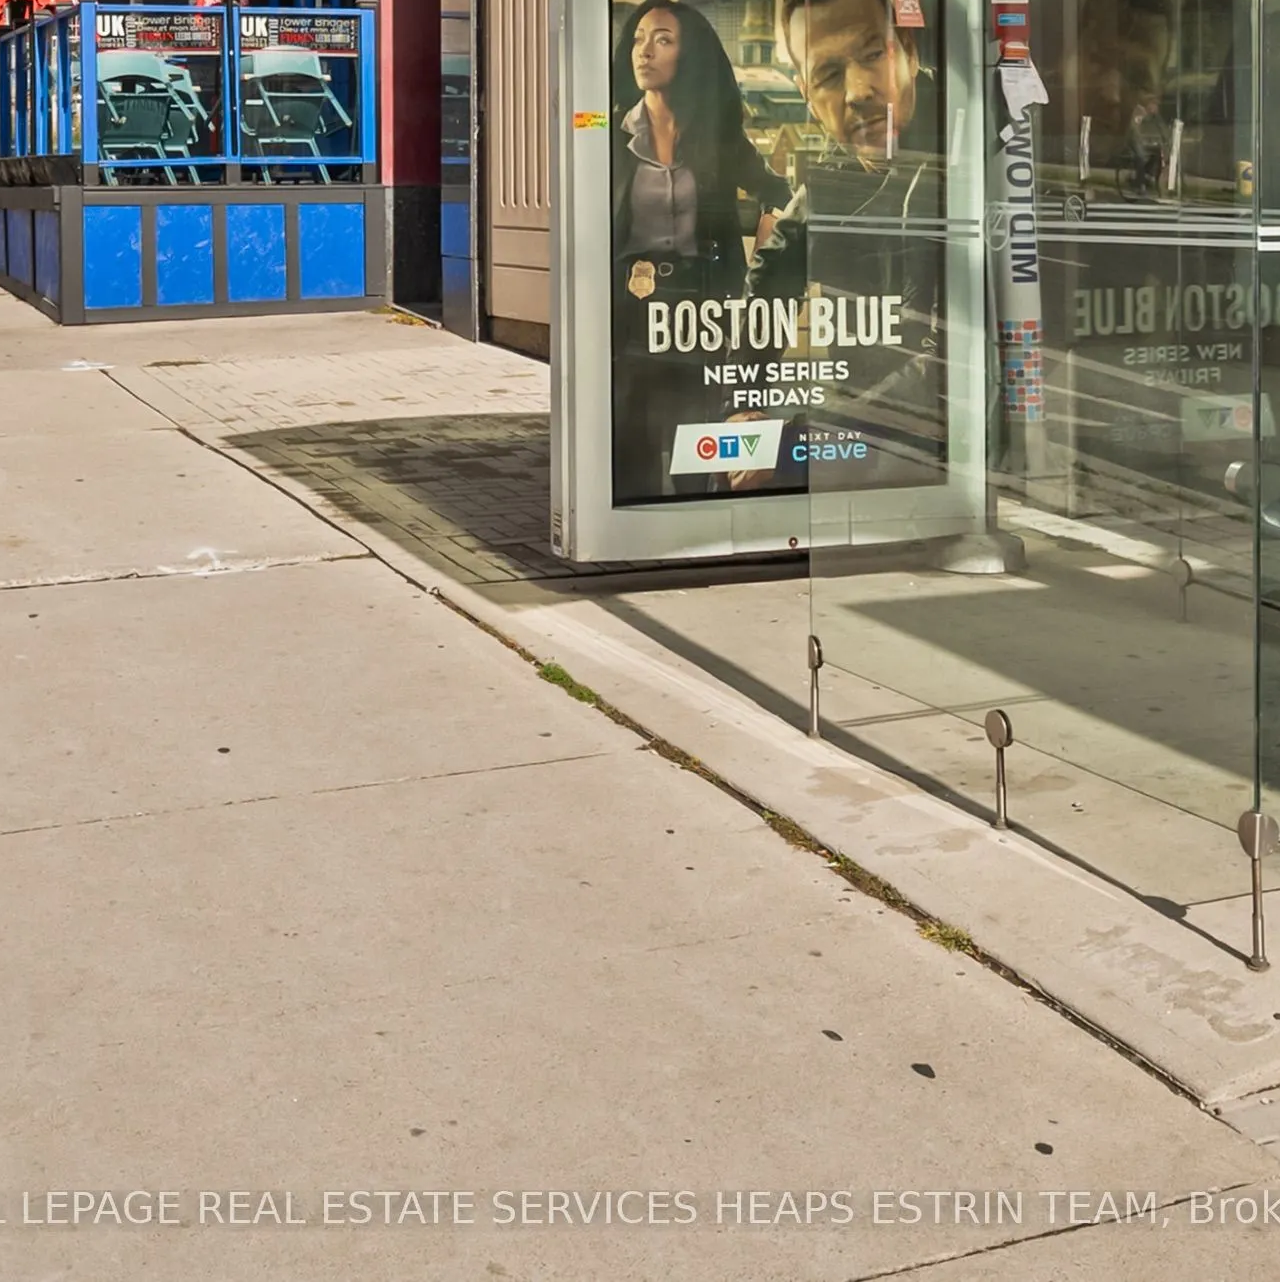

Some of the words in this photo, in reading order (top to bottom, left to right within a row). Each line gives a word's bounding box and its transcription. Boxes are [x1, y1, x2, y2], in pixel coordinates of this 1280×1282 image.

[97, 14, 125, 36] UK
[136, 15, 171, 25] Tower
[241, 16, 268, 37] UK
[648, 297, 798, 353] BOSTON
[810, 295, 902, 348] BLUE
[704, 364, 760, 386] NEW
[765, 360, 850, 383] SERIES
[733, 387, 825, 409] FRIDAYS
[696, 434, 762, 460] CTV
[799, 432, 830, 442] NEXT
[838, 431, 862, 441] DAY
